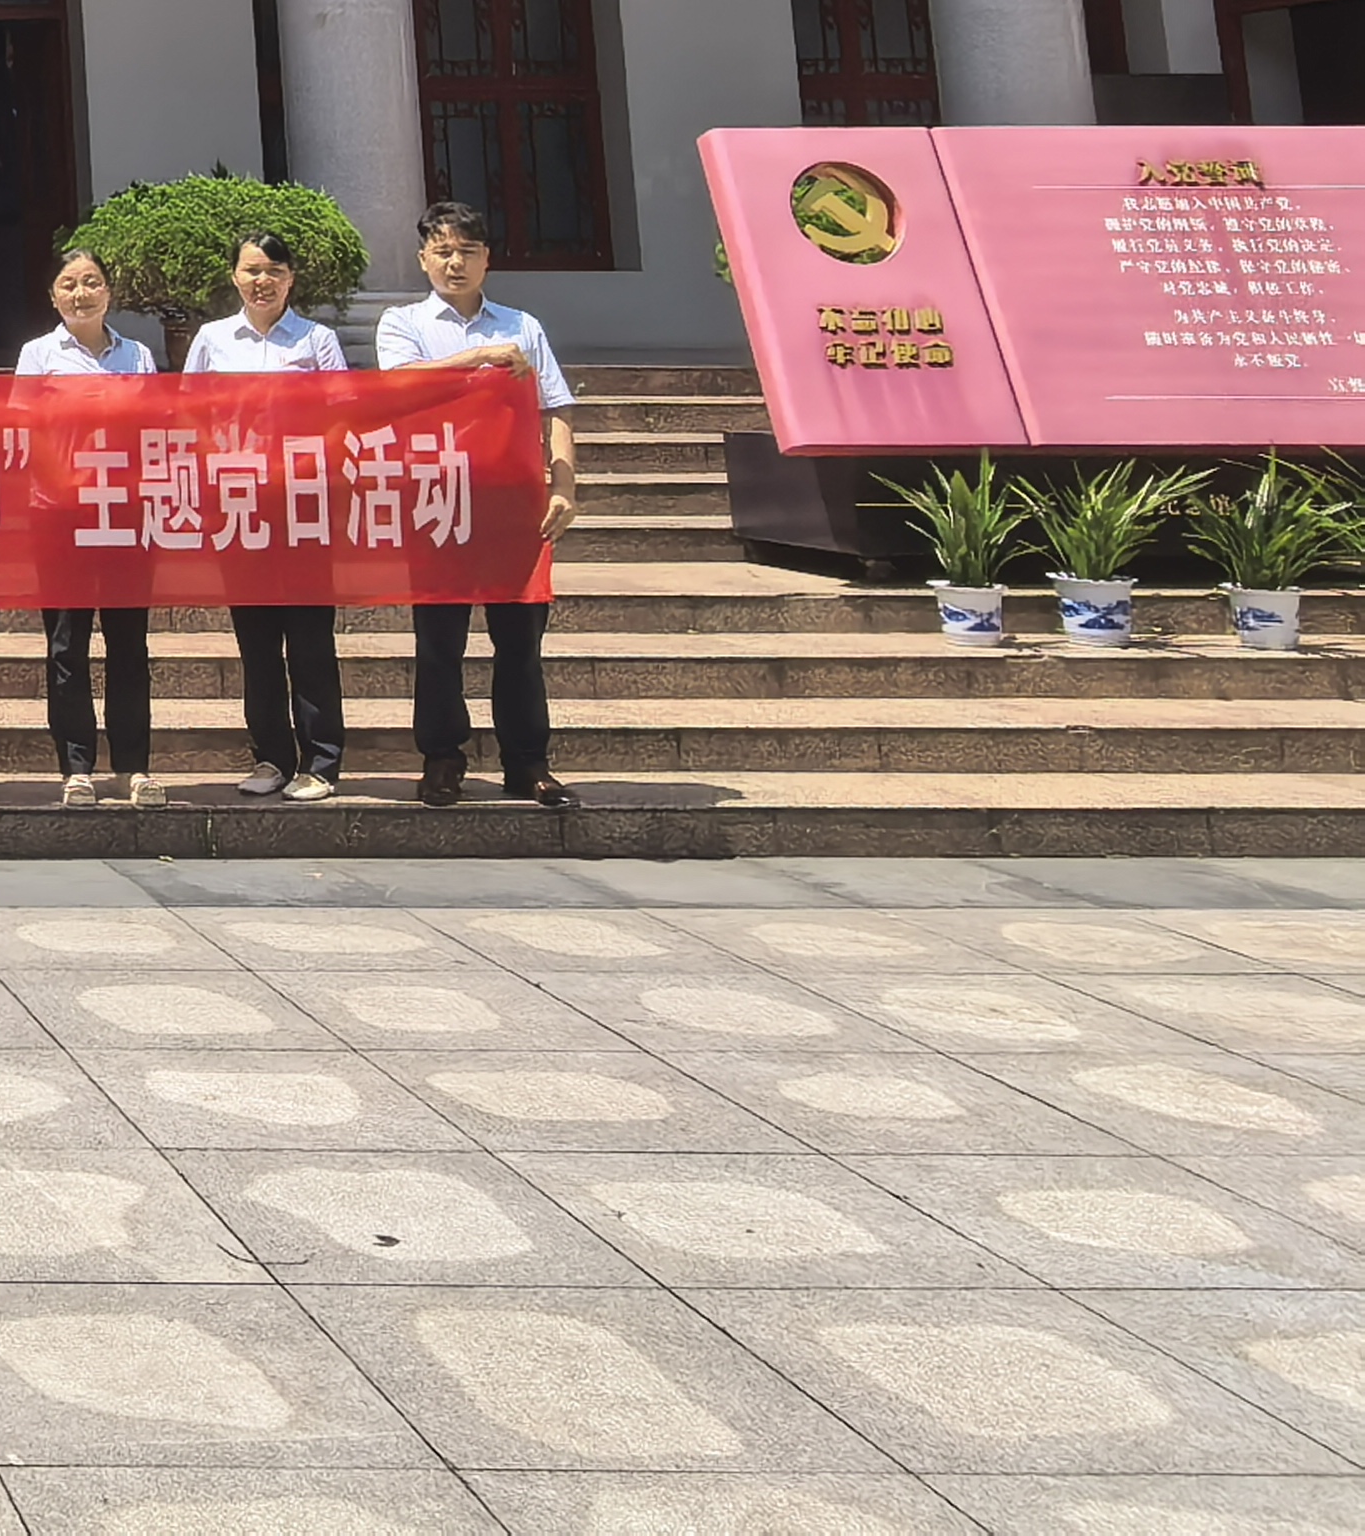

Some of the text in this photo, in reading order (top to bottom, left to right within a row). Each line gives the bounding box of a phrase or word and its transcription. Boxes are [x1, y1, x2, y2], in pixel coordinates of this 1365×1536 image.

[73, 421, 473, 552] 主题党日活动
